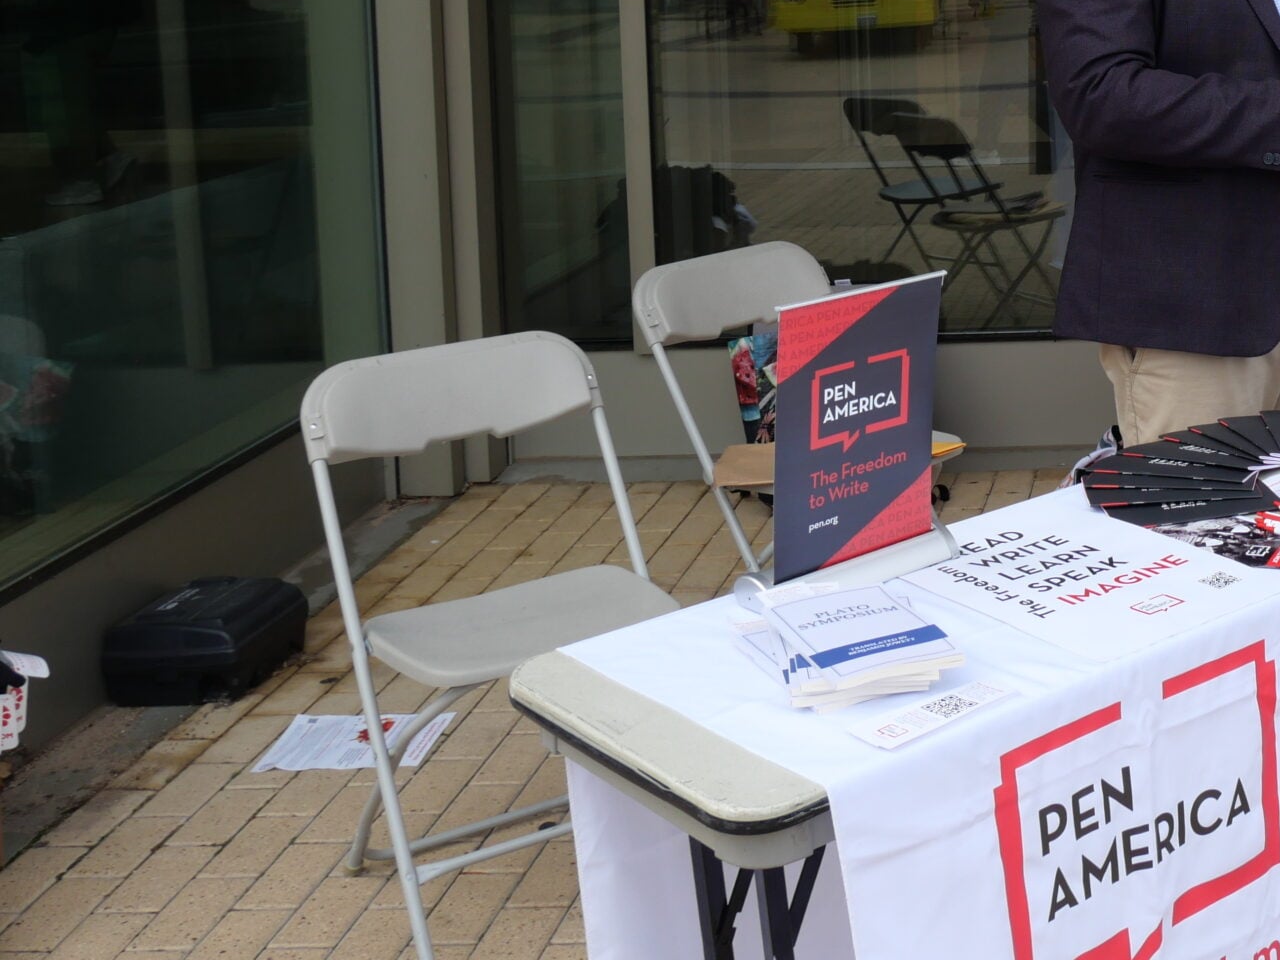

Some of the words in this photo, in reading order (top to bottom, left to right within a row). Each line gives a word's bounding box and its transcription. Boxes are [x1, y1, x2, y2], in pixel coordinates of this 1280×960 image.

[822, 390, 897, 424] AMERICA
[824, 381, 856, 405] PEN
[810, 469, 838, 490] The
[841, 451, 908, 480] Freedom
[808, 493, 826, 510] to
[828, 480, 870, 502] Write
[808, 516, 839, 534] pen.org
[960, 531, 1024, 556] EAD
[968, 535, 1070, 568] WRITE
[998, 544, 1102, 581] LEARN
[1028, 556, 1130, 593] SPEAK
[937, 565, 1020, 603] Freedom
[1057, 554, 1190, 606] IMAGINE
[797, 605, 899, 631] SYMPOSIUM
[814, 604, 870, 619] PLATO
[1018, 598, 1056, 619] The
[1038, 766, 1134, 857] PEN
[1048, 777, 1251, 923] AMERICA
